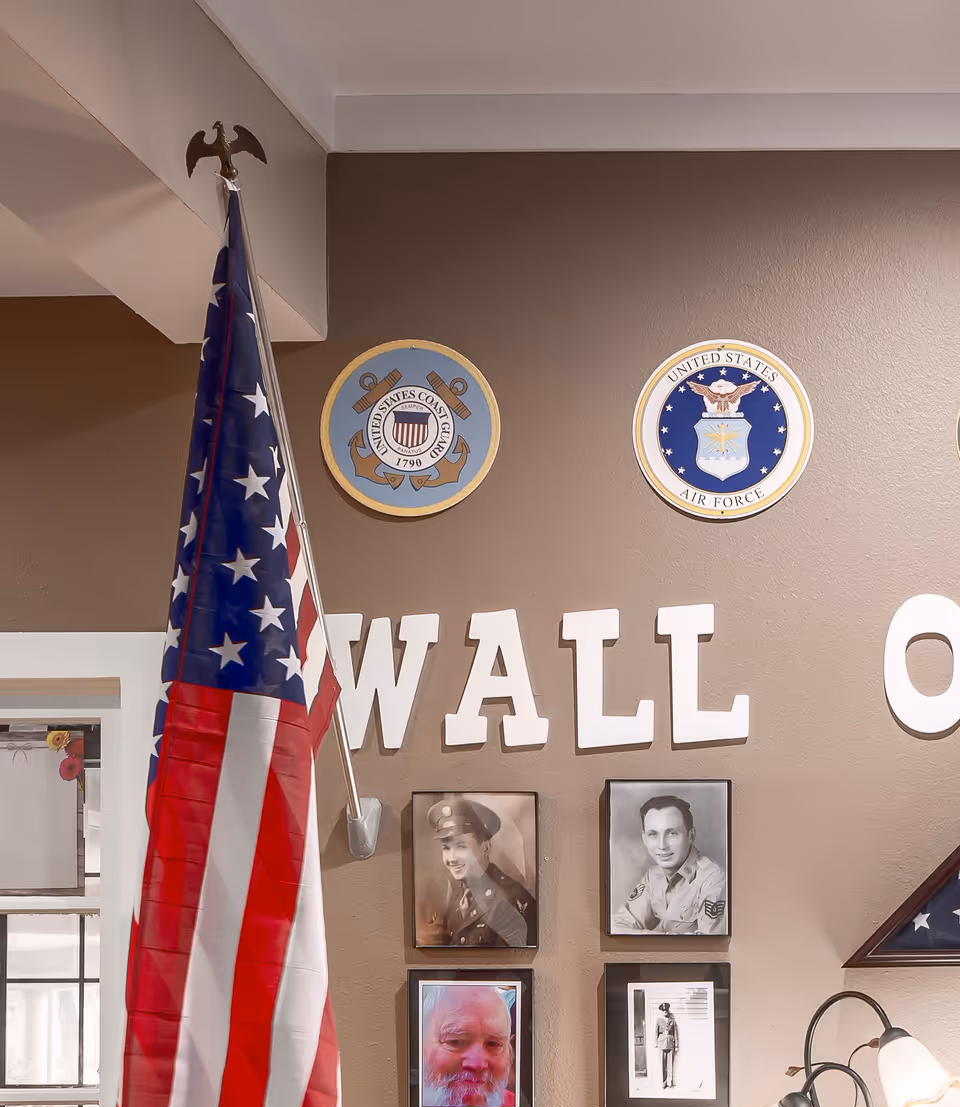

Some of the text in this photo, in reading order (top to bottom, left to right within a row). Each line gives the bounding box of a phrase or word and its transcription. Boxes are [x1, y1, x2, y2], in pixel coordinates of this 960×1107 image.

[667, 352, 779, 383] UNITED STATES
[371, 390, 450, 459] UNITED STATES COAST GUARD
[396, 457, 422, 468] 1790
[680, 487, 765, 508] AIR FORCE
[324, 603, 750, 750] WALL
